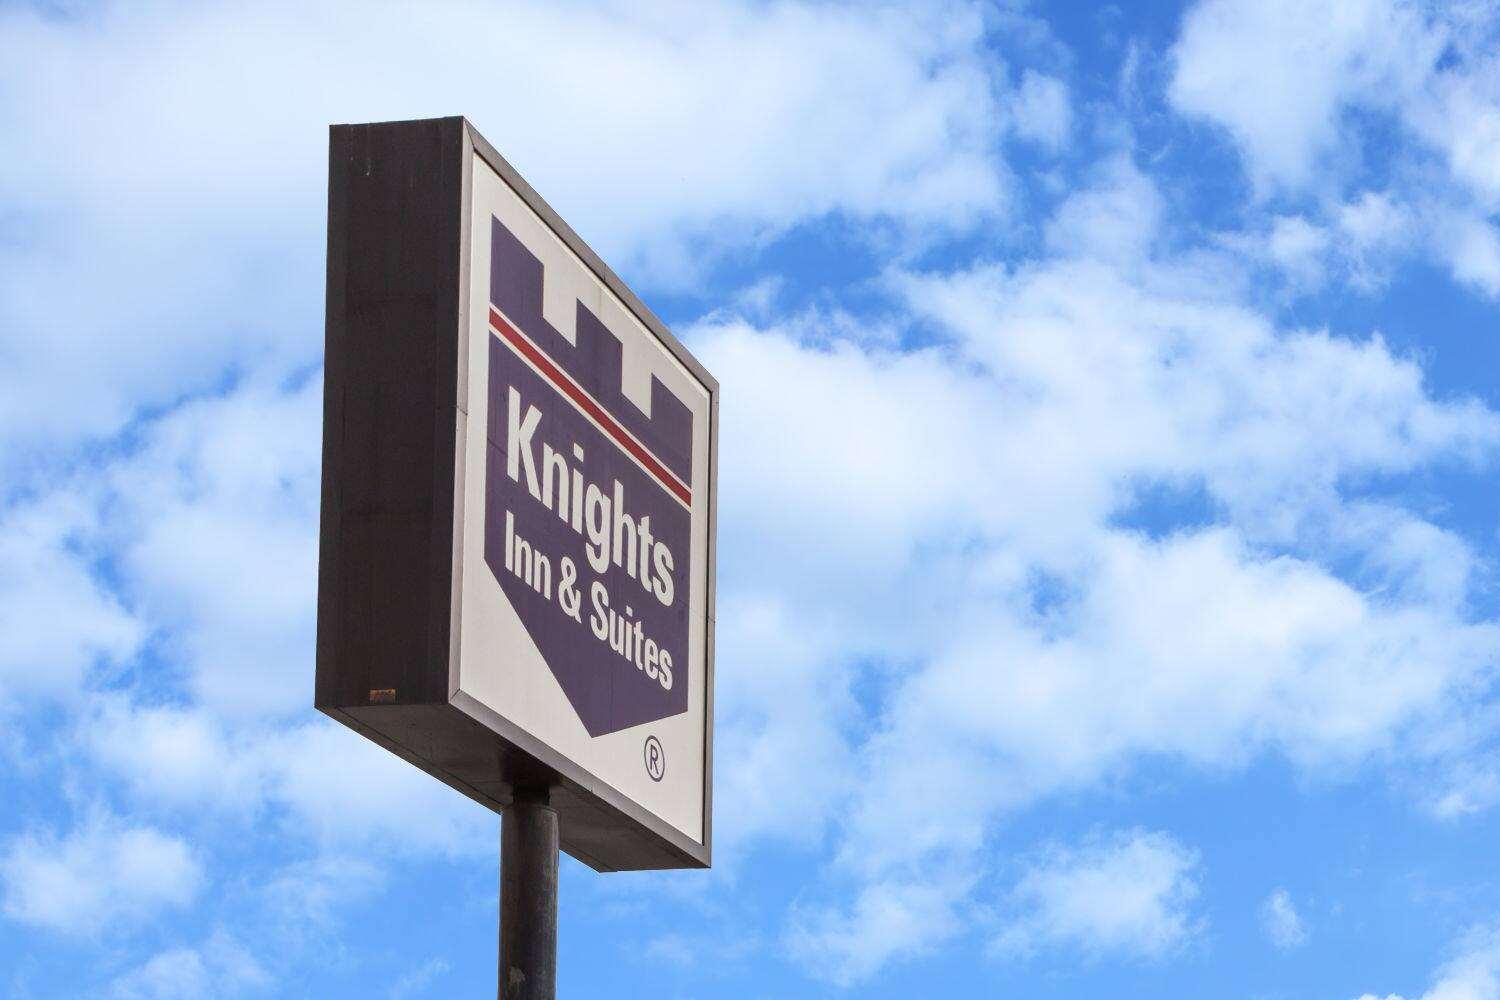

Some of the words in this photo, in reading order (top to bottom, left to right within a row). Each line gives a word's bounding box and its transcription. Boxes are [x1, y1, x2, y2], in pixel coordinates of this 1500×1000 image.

[507, 385, 674, 606] Knights
[505, 509, 552, 600] Inn
[558, 556, 582, 624] &
[590, 580, 673, 690] Suites
